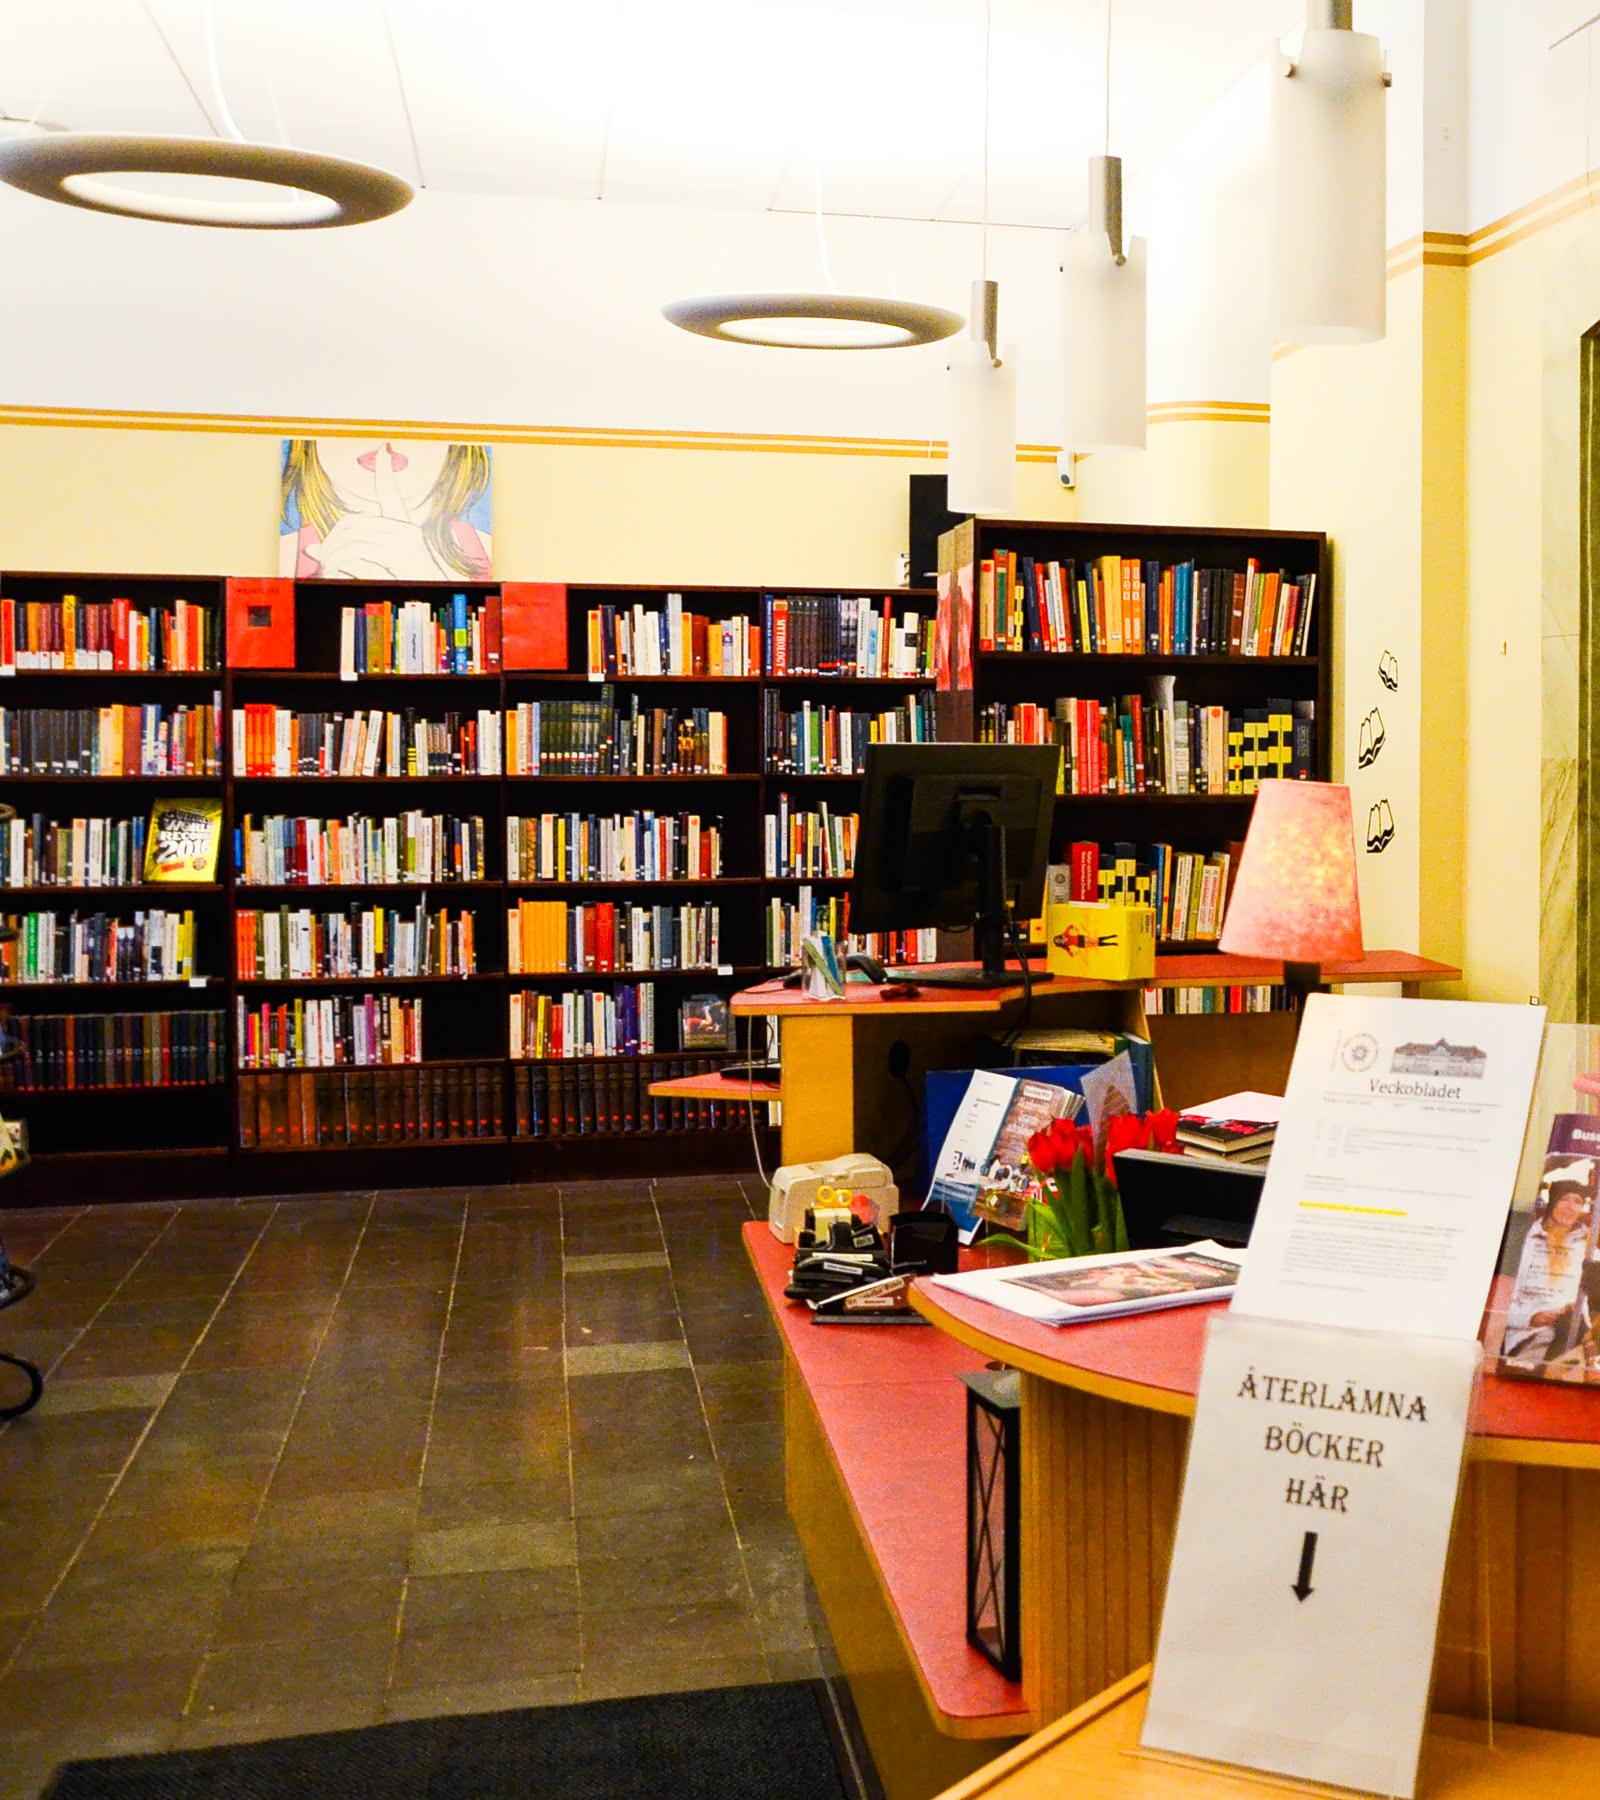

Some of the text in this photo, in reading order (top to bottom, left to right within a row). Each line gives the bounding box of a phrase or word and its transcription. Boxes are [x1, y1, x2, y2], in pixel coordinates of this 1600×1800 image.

[775, 619, 788, 668] MYTHOLOGY
[1369, 1078, 1461, 1099] Veckobladet
[1237, 1366, 1428, 1423] ÅTERLÄMNA
[1264, 1422, 1385, 1467] BÖCKER
[1285, 1475, 1349, 1513] HÄR
